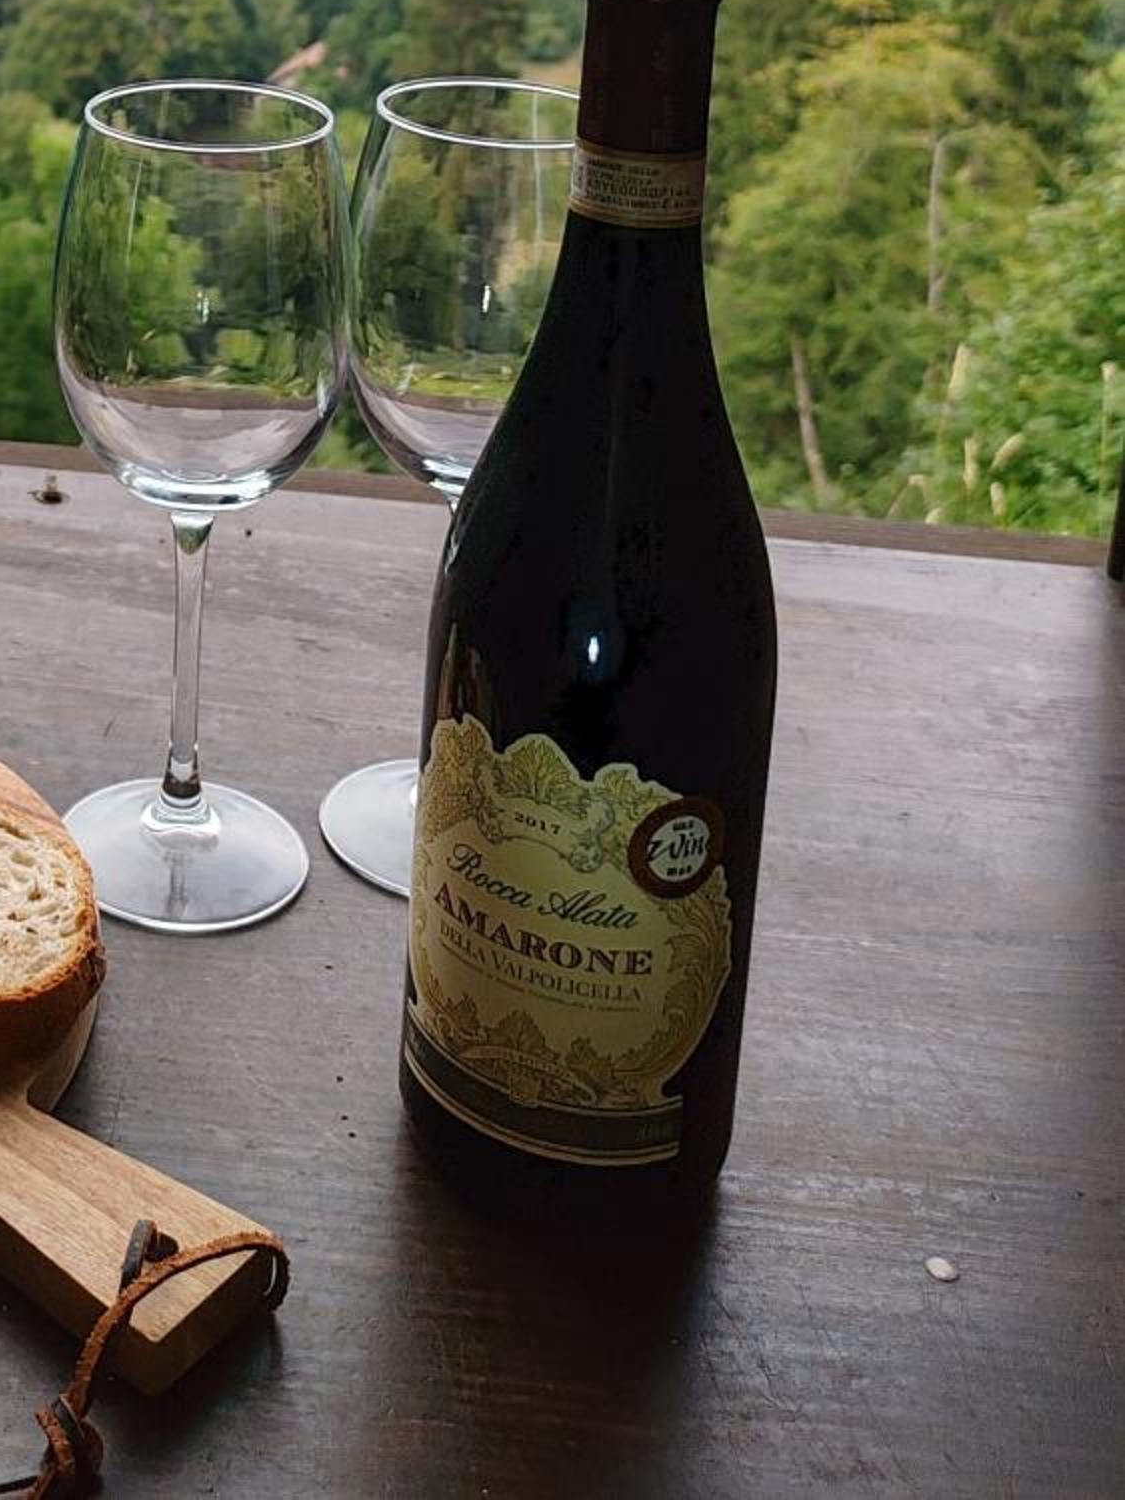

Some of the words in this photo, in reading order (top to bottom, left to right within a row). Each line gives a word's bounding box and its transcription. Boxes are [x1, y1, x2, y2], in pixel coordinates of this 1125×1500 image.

[514, 811, 561, 835] 2017
[446, 843, 533, 908] Rocca
[538, 890, 638, 929] Alata
[435, 883, 653, 975] AMARONE
[440, 919, 486, 964] DELLA
[489, 950, 641, 1001] VALPOLICELLA
